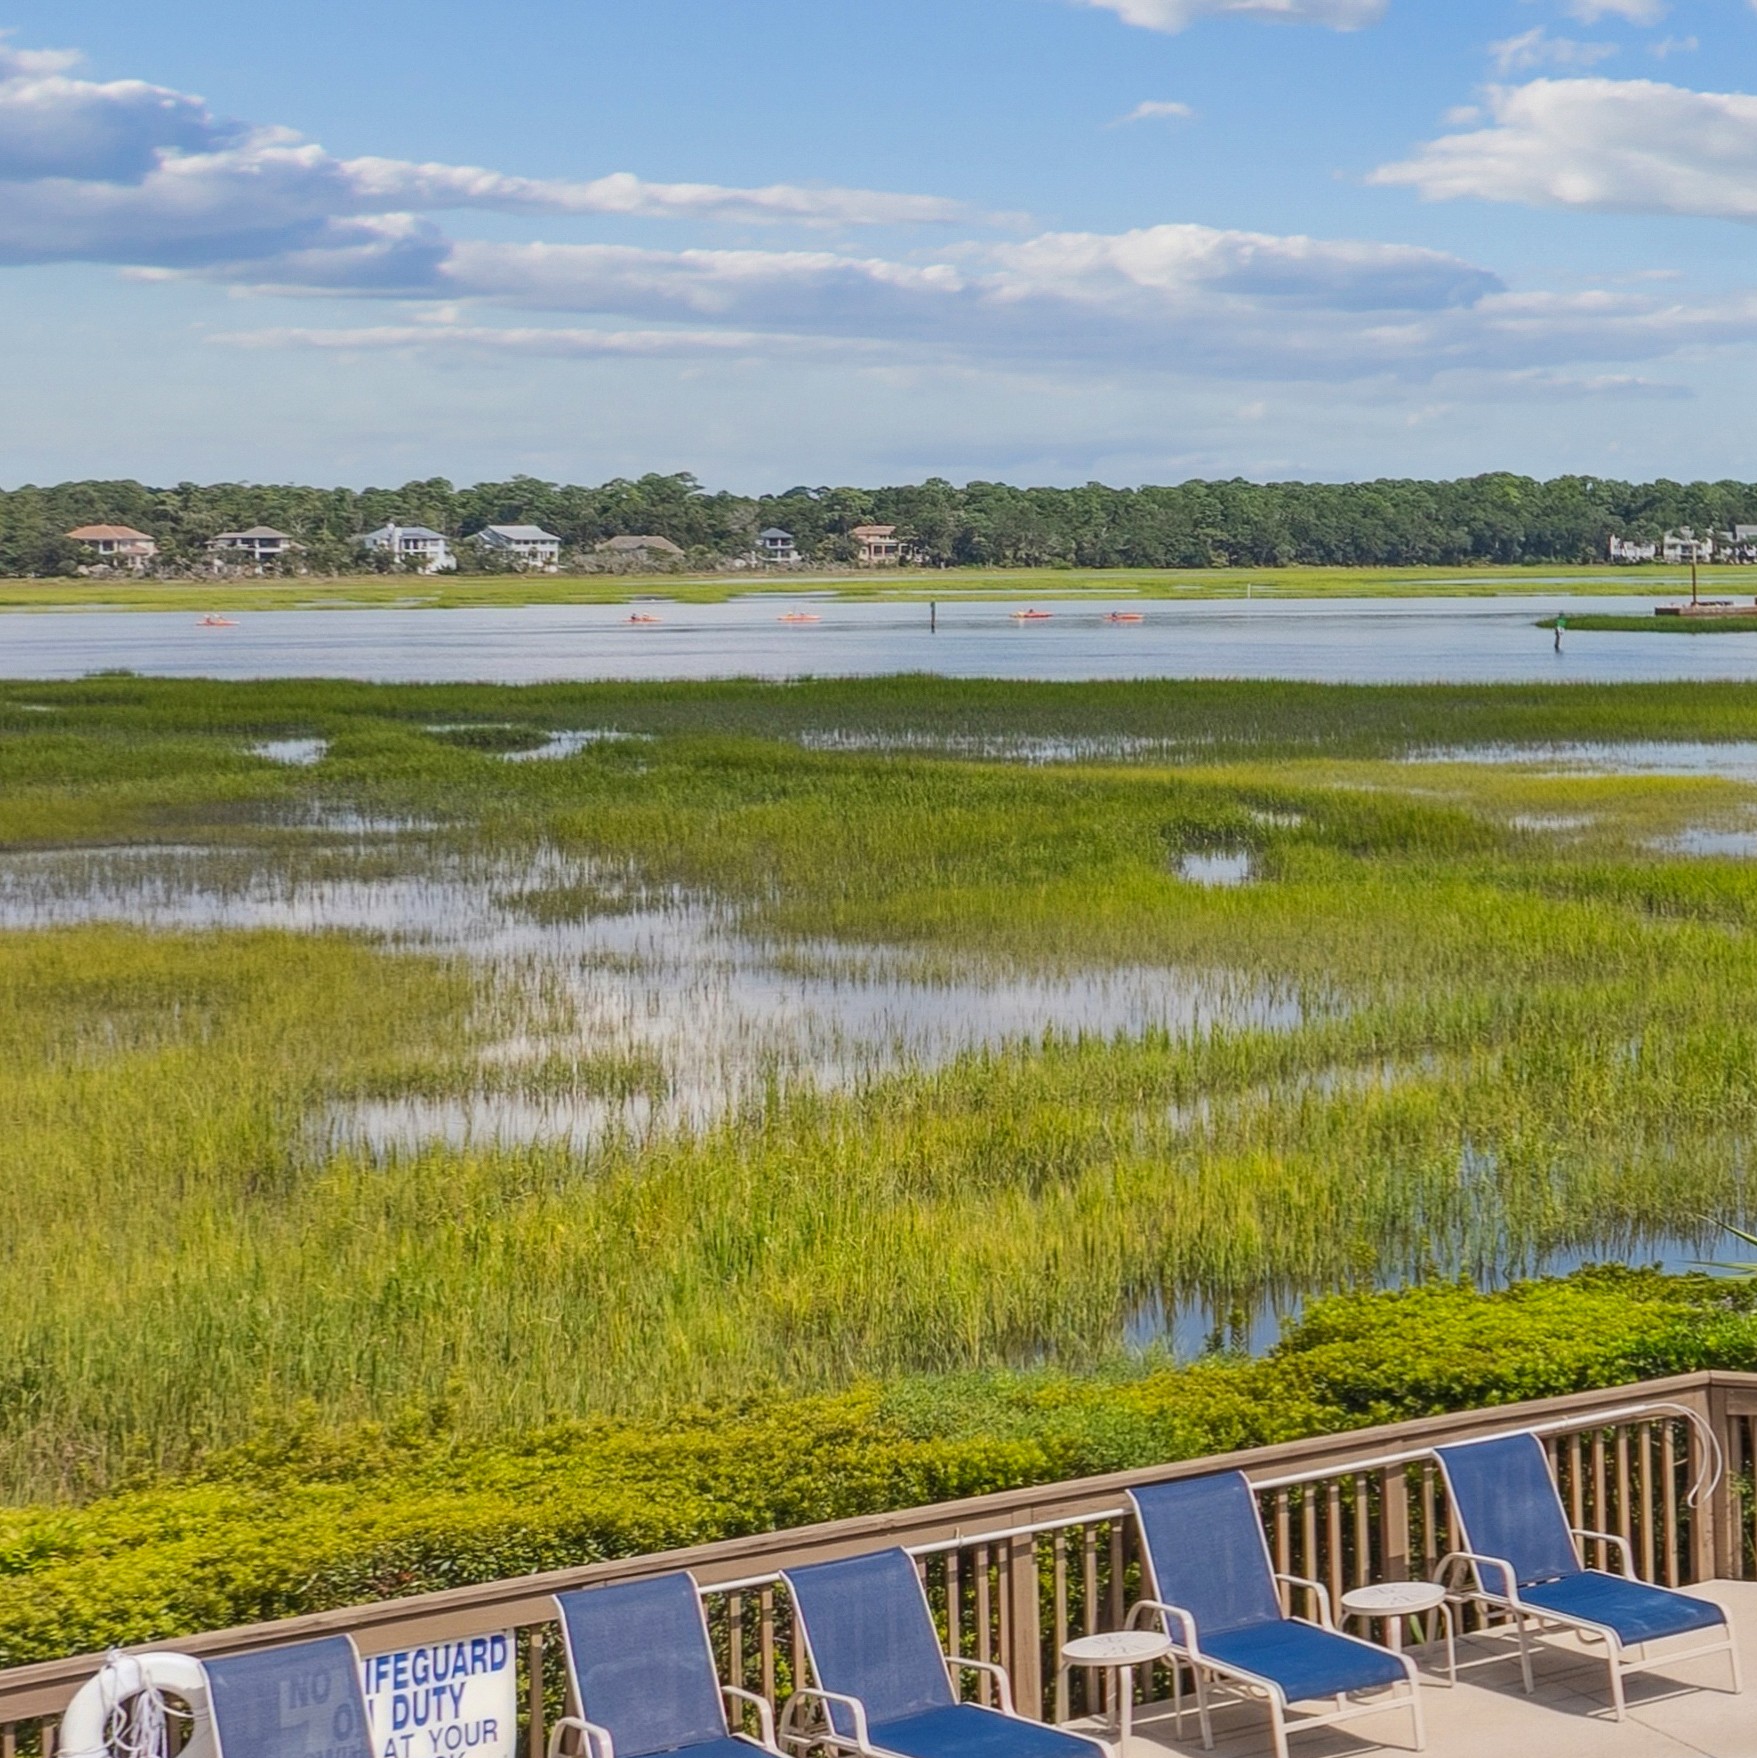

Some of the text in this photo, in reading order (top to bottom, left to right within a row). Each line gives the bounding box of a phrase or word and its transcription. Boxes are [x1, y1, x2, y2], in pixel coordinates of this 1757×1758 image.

[365, 1635, 508, 1696] IFEGUARD
[392, 1682, 466, 1731] DUTY
[429, 1719, 498, 1751] YOUR
